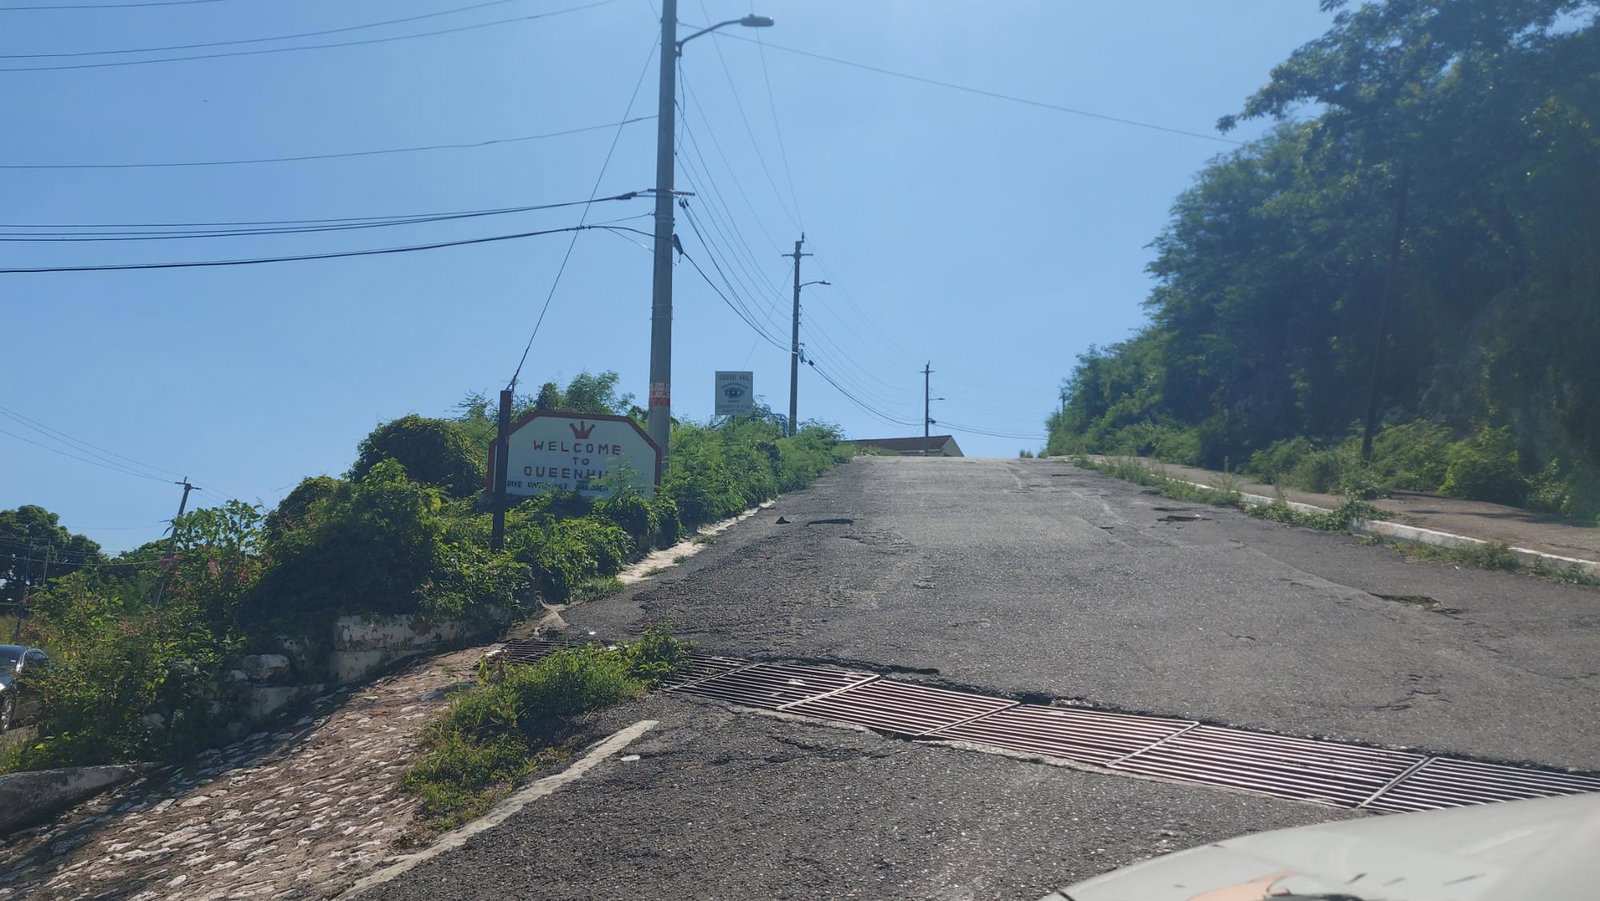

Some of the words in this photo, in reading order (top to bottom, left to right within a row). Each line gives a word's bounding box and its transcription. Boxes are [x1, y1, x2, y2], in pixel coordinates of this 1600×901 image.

[533, 439, 622, 456] WELCOME
[573, 456, 590, 466] TO
[524, 466, 612, 480] QUEENHI
